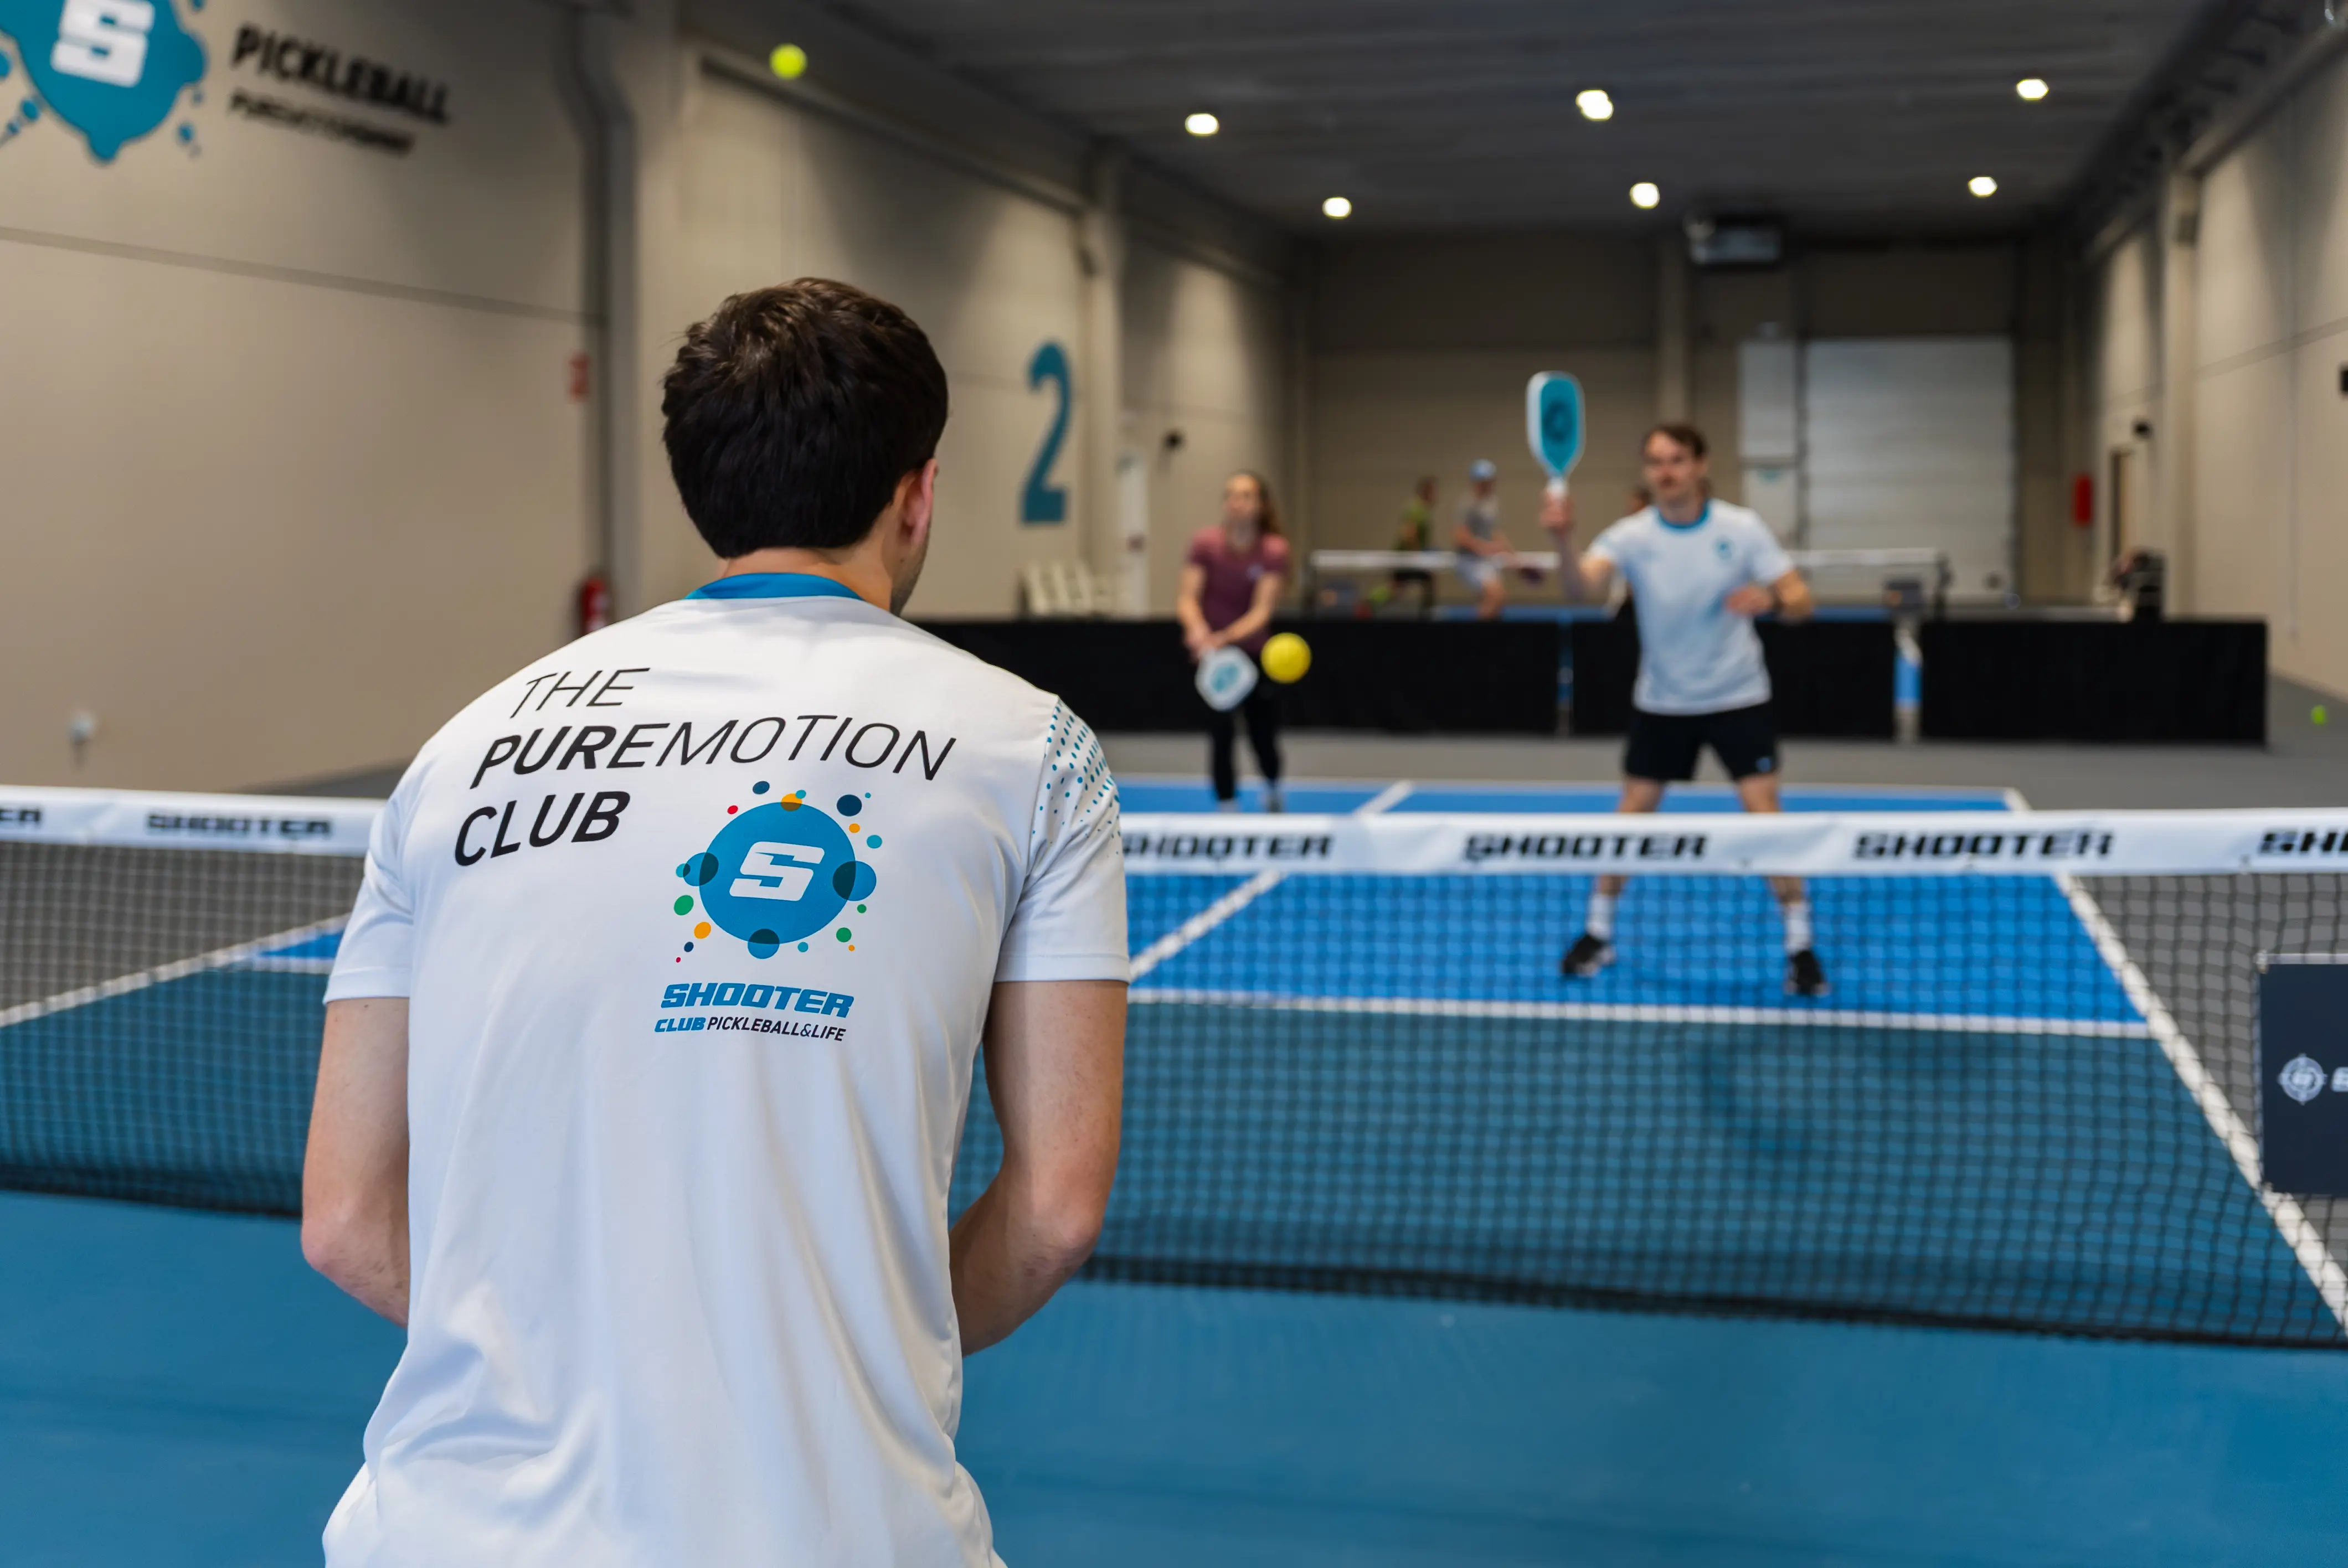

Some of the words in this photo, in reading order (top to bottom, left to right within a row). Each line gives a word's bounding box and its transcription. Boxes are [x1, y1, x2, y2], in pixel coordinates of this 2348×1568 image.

[231, 23, 450, 125] PICKLEBALL
[1021, 342, 1072, 523] 2
[510, 667, 650, 719] THE
[470, 714, 957, 790] PUREMOTION
[454, 791, 631, 866] CLUB
[1465, 832, 1708, 860] SHOOTER
[1855, 831, 2113, 858] SHOOTER
[2258, 829, 2348, 855] SH
[729, 840, 825, 902] S
[653, 1016, 707, 1033] CLUB
[660, 982, 854, 1019] SHOOTER
